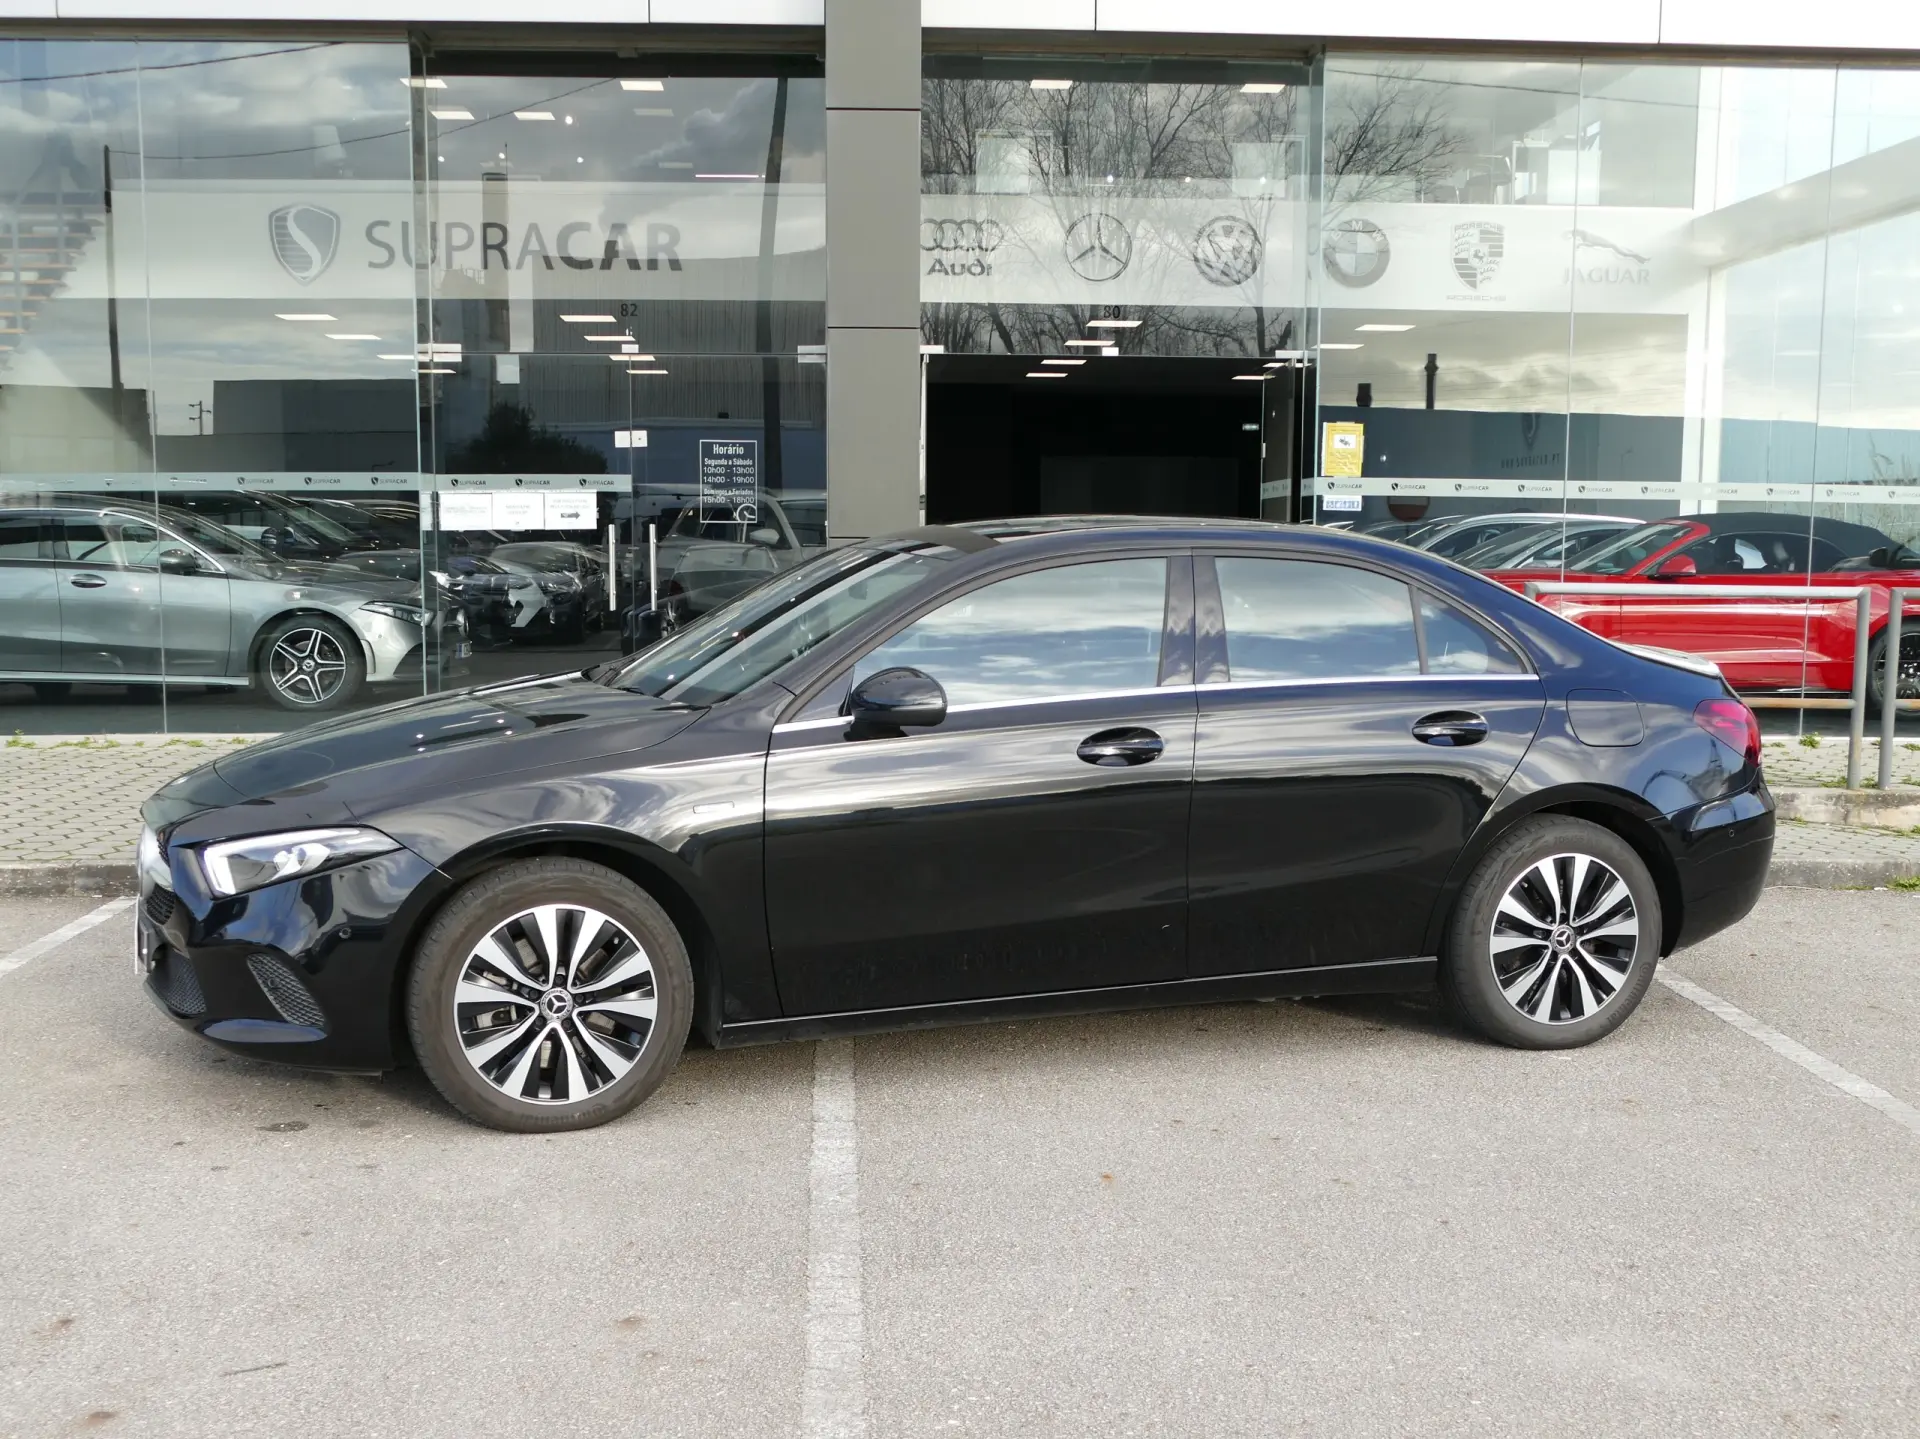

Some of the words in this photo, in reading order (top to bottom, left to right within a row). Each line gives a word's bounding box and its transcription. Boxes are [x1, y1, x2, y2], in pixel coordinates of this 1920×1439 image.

[365, 220, 682, 271] SUPRACAR
[1563, 267, 1651, 285] JAGUAR
[620, 303, 638, 317] 82
[1103, 305, 1120, 318] 80
[713, 444, 744, 454] Horário
[704, 458, 727, 466] Segunda
